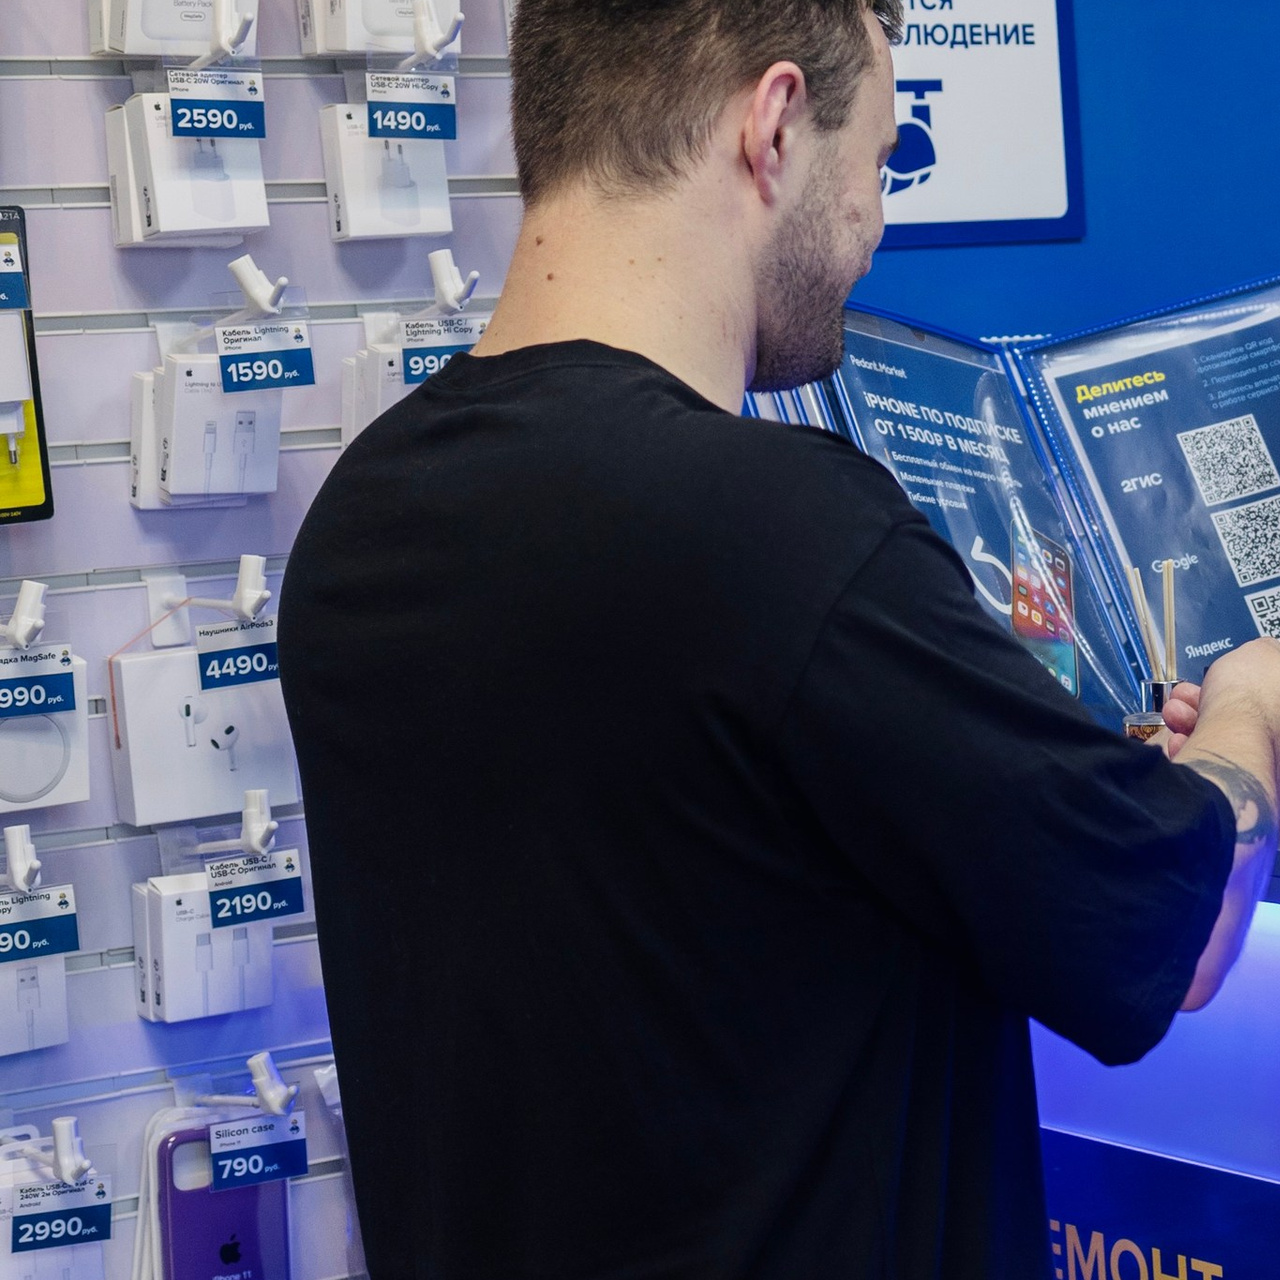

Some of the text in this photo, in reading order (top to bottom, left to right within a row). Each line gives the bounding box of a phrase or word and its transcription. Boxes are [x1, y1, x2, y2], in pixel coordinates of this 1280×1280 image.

[897, 23, 1035, 48] ЛЮДЕНИЕ
[176, 108, 238, 129] 2590
[239, 122, 255, 131] руб.
[372, 110, 441, 132] 1490 руб.
[222, 326, 289, 337] Кабель Lightning
[223, 335, 262, 344] Оригинал
[405, 328, 441, 337] Lightning
[453, 326, 473, 334] Copy
[1244, 341, 1257, 350] QR
[227, 359, 300, 383] 1590 руб.
[850, 355, 907, 379] Pedant.Market
[1075, 371, 1166, 404] Делитесь
[1083, 389, 1169, 419] мнением
[863, 391, 1023, 445] iPHONE ПО ПОДПИСКЕ
[1091, 417, 1141, 438] о нас
[874, 419, 896, 437] ОТ
[945, 436, 958, 451] В
[959, 440, 1010, 465] МЕСЯЦ
[1121, 472, 1163, 493] 2ГИС
[1151, 553, 1199, 573] Gogle
[199, 620, 273, 637] Наушники AirPods3
[20, 653, 56, 663] MagSafe
[1185, 638, 1234, 659] Яндекс
[206, 653, 268, 678] 4490
[47, 695, 64, 704] руб.
[210, 856, 267, 871] Кабель USB-C
[211, 869, 236, 878] USB-C
[11, 893, 50, 905] Lightning
[216, 891, 288, 918] 2190 руб.
[32, 939, 49, 948] руб.
[215, 1123, 275, 1139] Silicon case
[218, 1154, 263, 1179] 790
[18, 1217, 98, 1243] 2990 руб.
